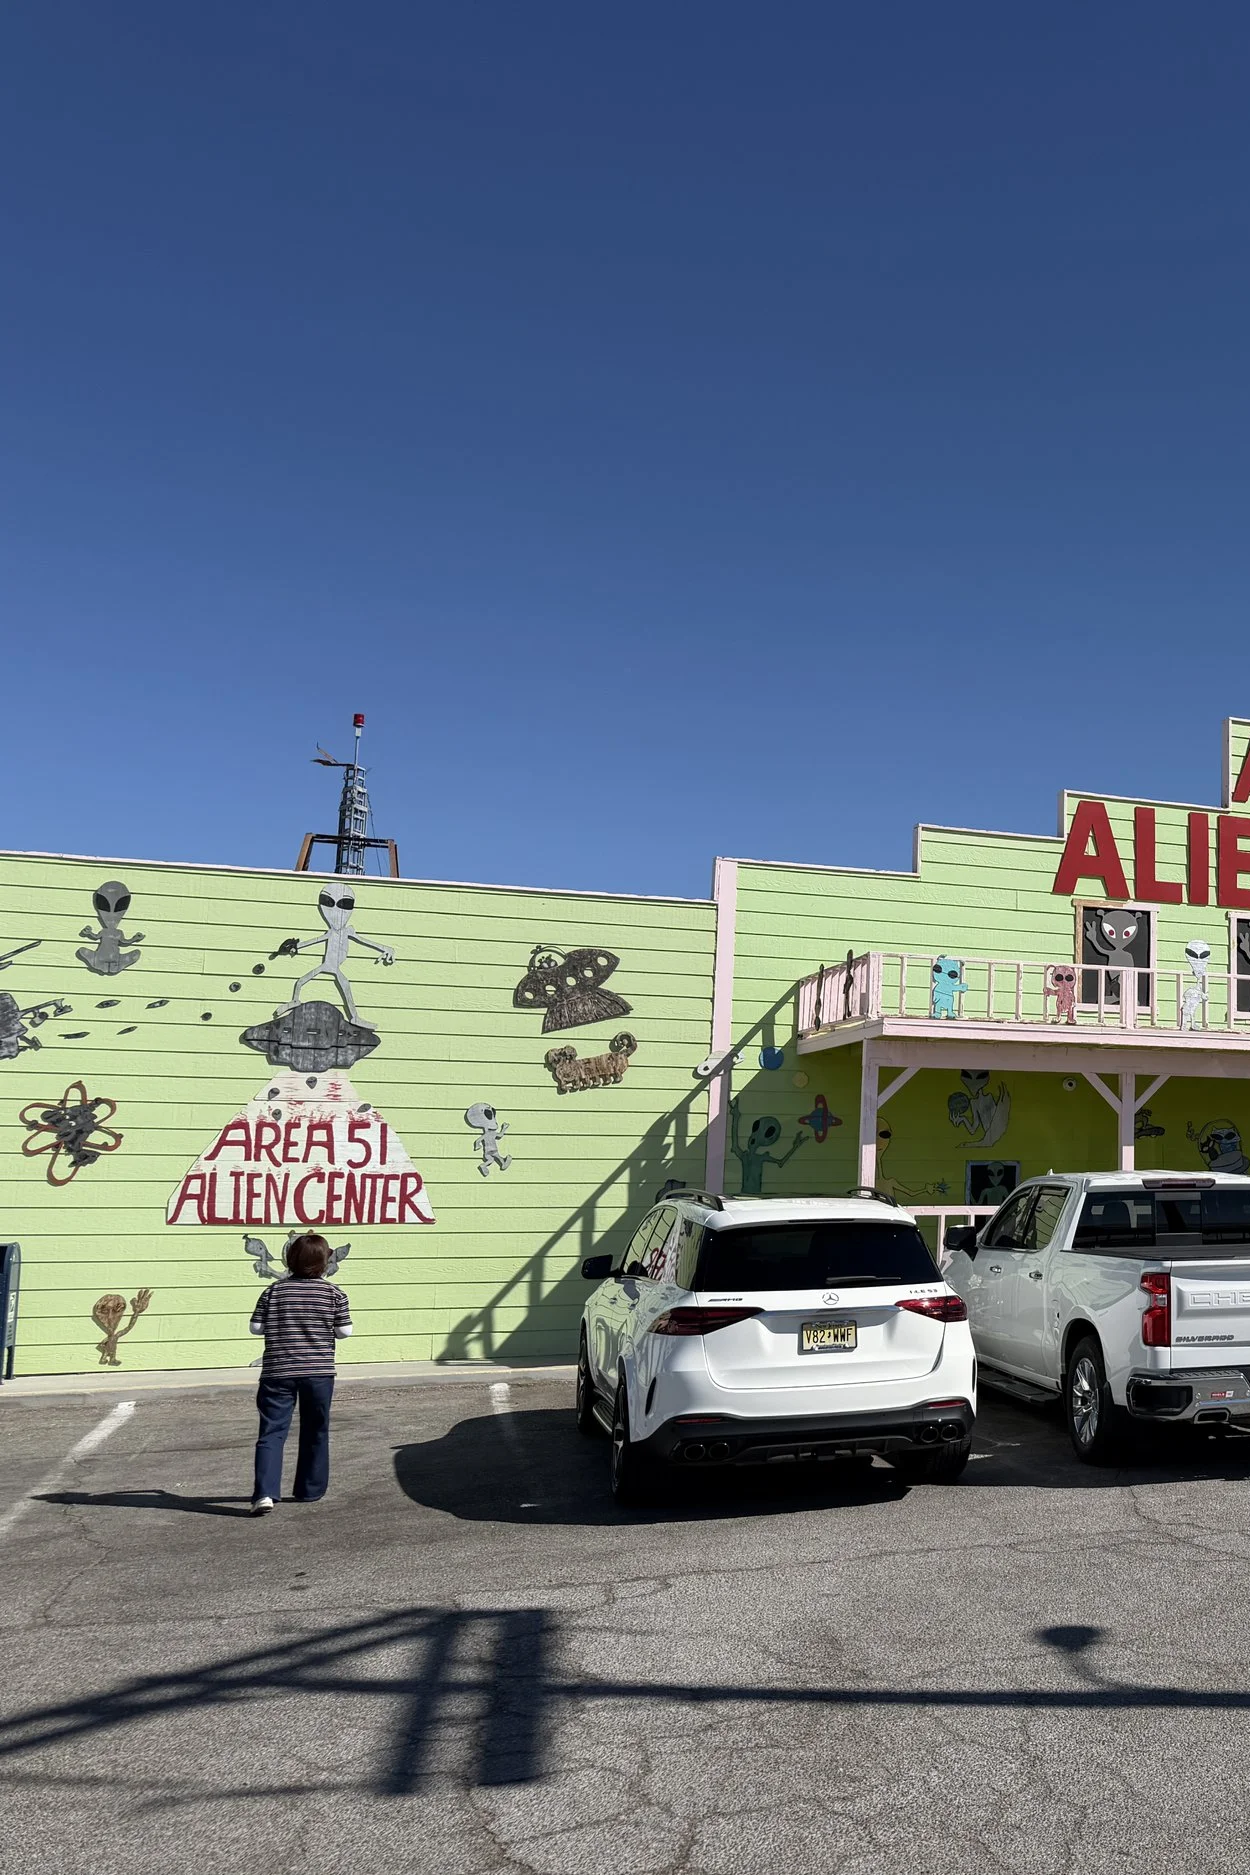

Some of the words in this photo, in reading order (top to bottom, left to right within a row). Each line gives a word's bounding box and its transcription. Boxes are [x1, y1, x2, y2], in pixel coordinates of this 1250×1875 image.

[204, 1121, 335, 1167] AREA
[347, 1122, 387, 1169] 51
[168, 1170, 290, 1225] ALIEN
[294, 1170, 436, 1225] CENTER
[1175, 1334, 1235, 1343] SILVERADO
